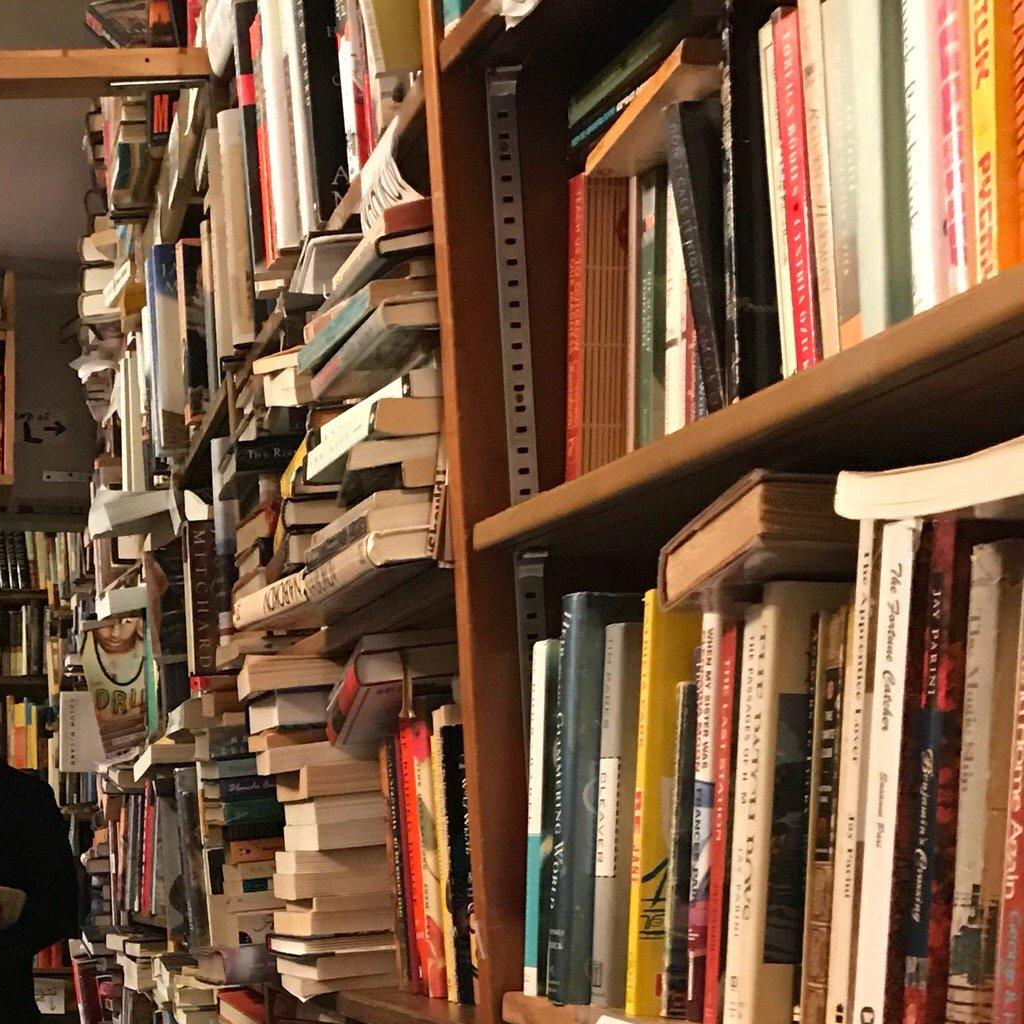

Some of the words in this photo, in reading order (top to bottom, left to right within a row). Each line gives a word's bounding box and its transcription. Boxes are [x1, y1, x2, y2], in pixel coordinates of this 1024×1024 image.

[781, 29, 796, 118] FOREIGN
[786, 123, 801, 197] BODIES
[683, 242, 700, 288] NIGHT
[793, 218, 808, 304] CYNTHIA
[193, 530, 212, 669] MITCHARD
[862, 552, 872, 585] The
[888, 563, 904, 595] The
[883, 599, 901, 663] Fortune
[930, 589, 942, 620] JAY
[602, 638, 614, 658] TIM
[703, 626, 715, 670] WHEN
[722, 659, 732, 698] THE
[747, 635, 756, 663] THE
[856, 594, 869, 702] Apprentice
[927, 628, 940, 696] PARINI
[601, 661, 613, 729] PARKS
[703, 673, 713, 696] MY
[743, 668, 755, 744] PASSAGES
[880, 669, 898, 733] Catcher
[701, 698, 713, 740] SISTER
[719, 702, 729, 750] LAST
[852, 708, 864, 763] Lover
[553, 711, 566, 836] GLIMMERING
[699, 741, 710, 770] WAS
[596, 771, 608, 864] CLEAVER
[714, 757, 726, 842] STATION
[914, 747, 935, 847] Benjamin's
[547, 840, 566, 911] WORLD
[843, 847, 855, 900] Parini
[911, 848, 928, 923] Crossing
[1003, 818, 1024, 901] Again
